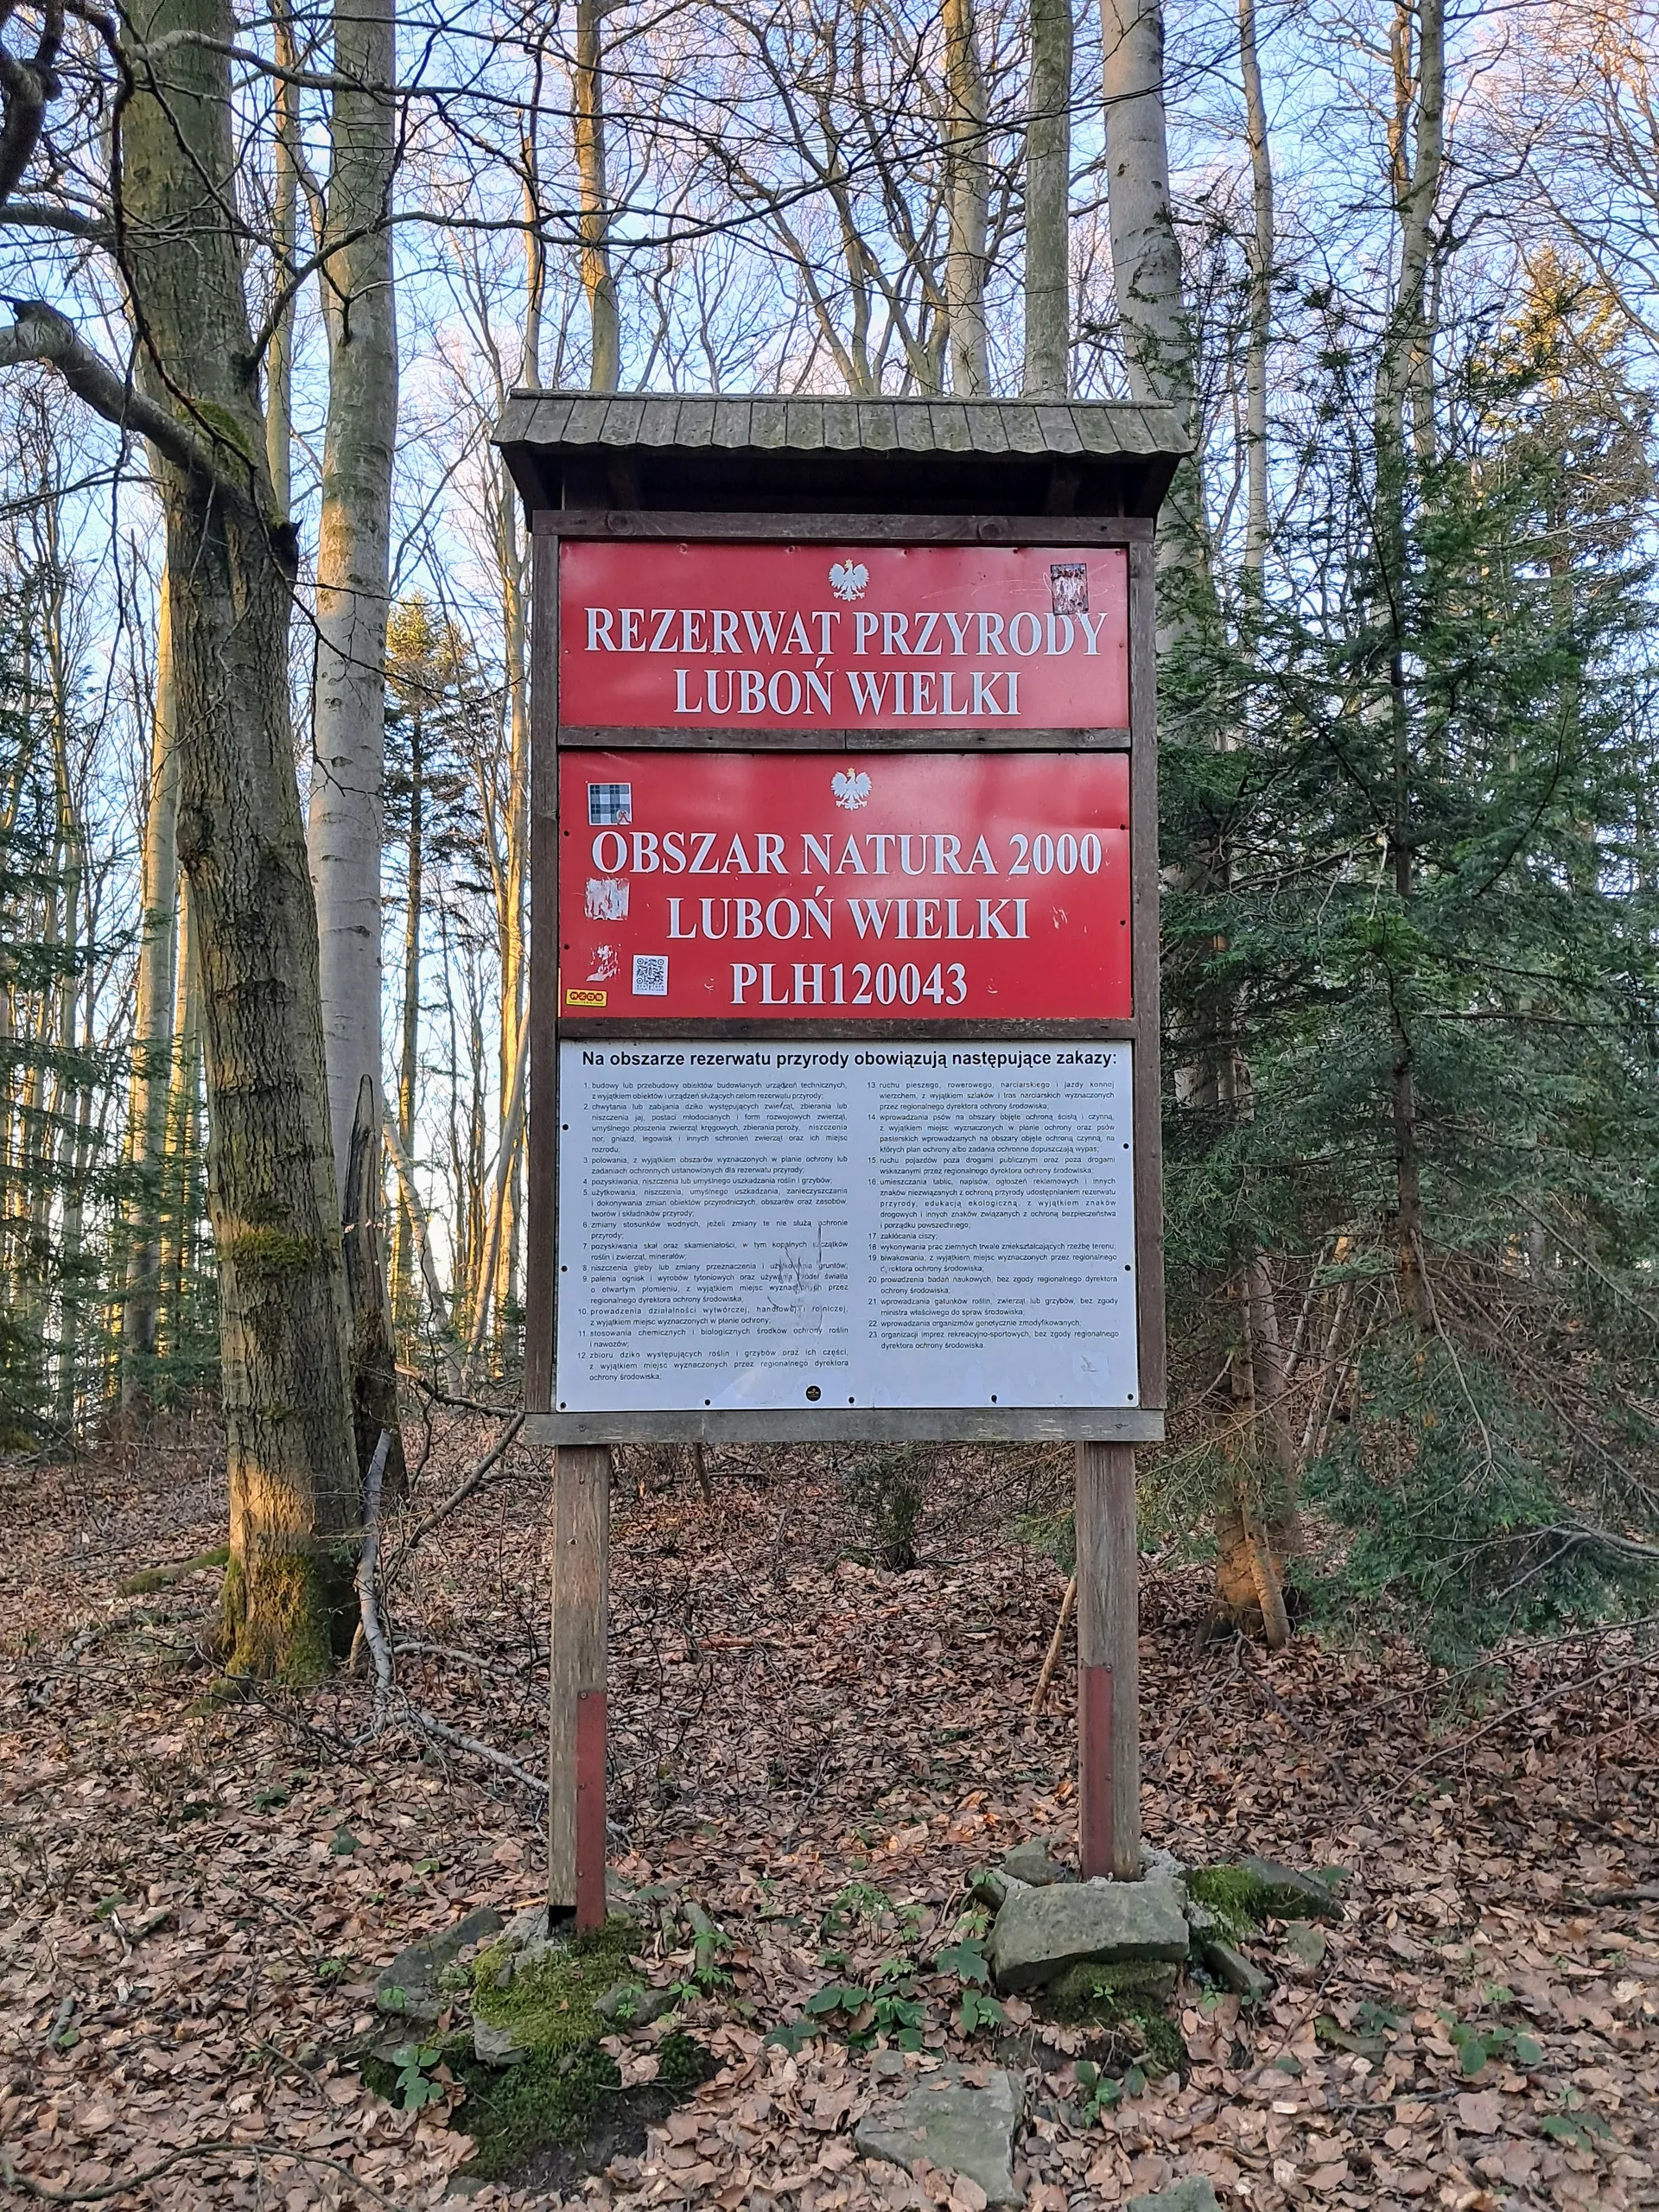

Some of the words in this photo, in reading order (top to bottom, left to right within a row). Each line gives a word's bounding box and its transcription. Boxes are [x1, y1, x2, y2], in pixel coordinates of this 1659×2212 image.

[584, 608, 840, 654] REZERWAT
[853, 612, 1107, 656] PRZYRODY
[673, 658, 834, 715] LUBOŃ
[848, 671, 1020, 715] WIELKI
[593, 831, 789, 874] OBSZAR
[801, 833, 998, 875] NATURA
[1008, 833, 1102, 875] 2000
[667, 886, 835, 939] LUBOŃ
[848, 897, 1030, 940] WIELKI
[730, 963, 967, 1004] PLH120043
[583, 1052, 604, 1065] Na
[610, 1052, 684, 1065] obszarze
[691, 1052, 770, 1065] rezerwatu
[777, 1052, 849, 1069] przyrody
[855, 1051, 948, 1068] obowiązują
[953, 1051, 1051, 1068] następujące
[1057, 1051, 1118, 1068] zakazy:
